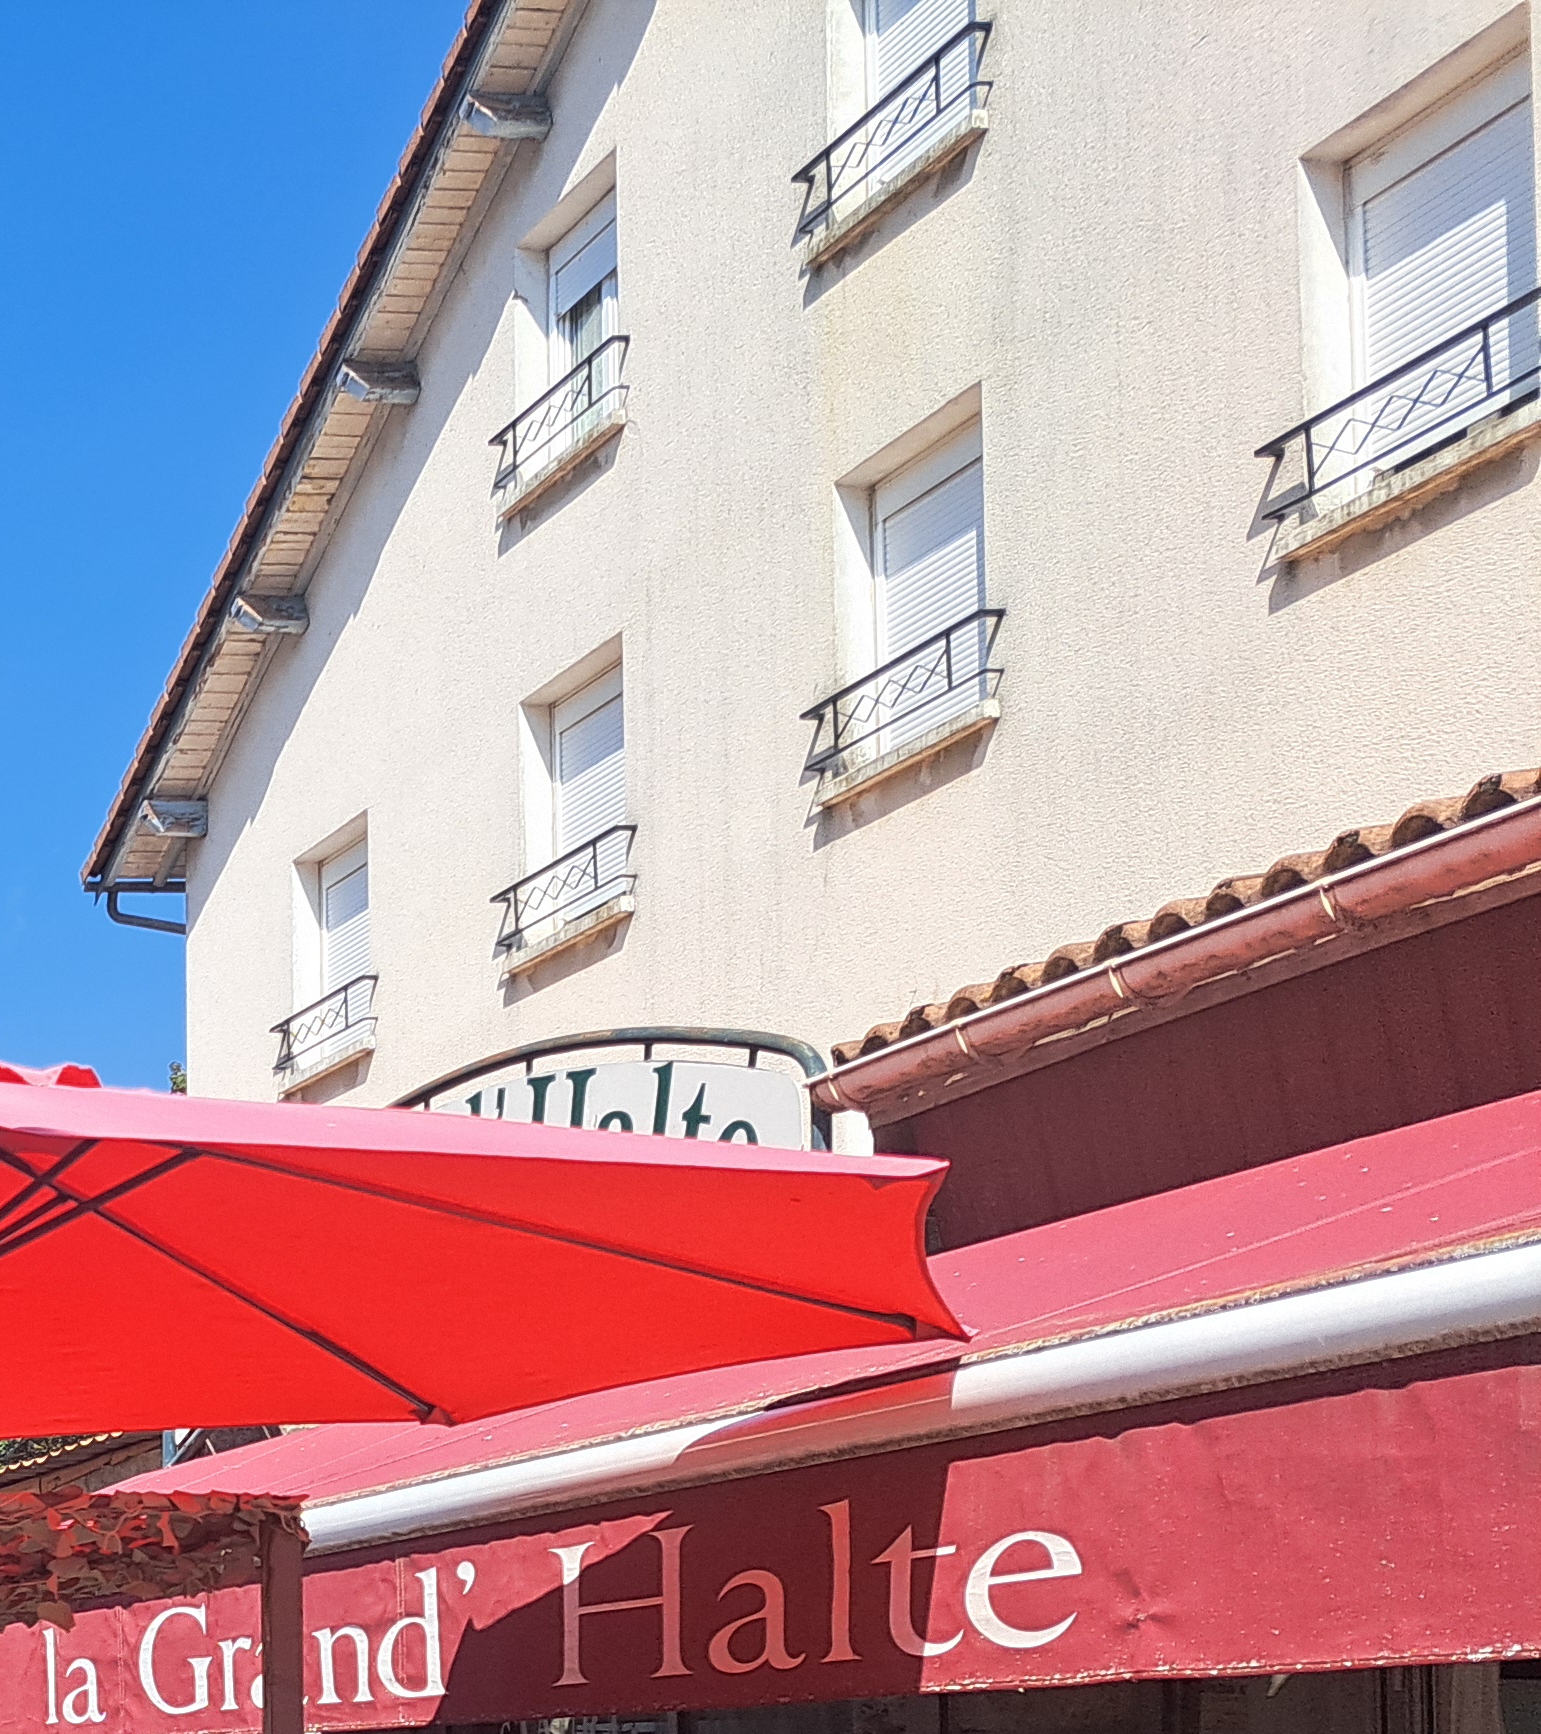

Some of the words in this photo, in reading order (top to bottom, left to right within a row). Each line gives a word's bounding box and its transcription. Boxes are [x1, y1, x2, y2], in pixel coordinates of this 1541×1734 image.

[45, 1627, 106, 1725] la
[138, 1561, 476, 1716] Grnd'
[547, 1499, 1083, 1687] Halte
